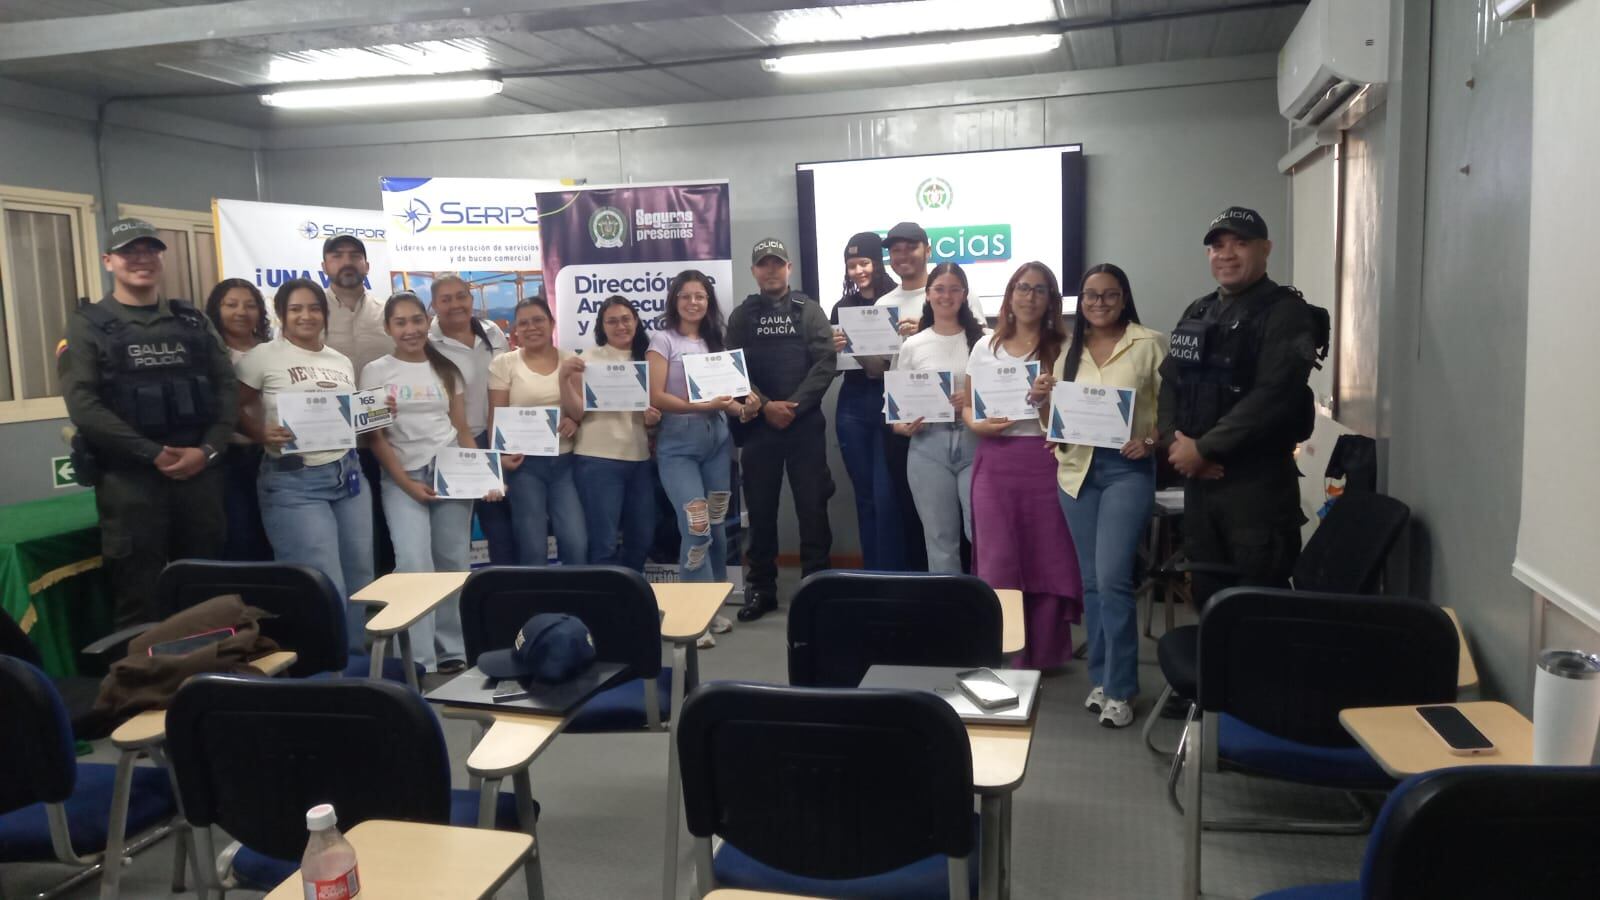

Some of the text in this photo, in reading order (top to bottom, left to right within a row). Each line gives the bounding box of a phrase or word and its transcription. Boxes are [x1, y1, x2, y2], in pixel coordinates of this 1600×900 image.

[636, 209, 693, 228] Seguros
[636, 228, 693, 241] presentes
[439, 243, 447, 251] la
[450, 243, 491, 253] prestación
[493, 243, 502, 251] de
[504, 243, 539, 251] servicios
[754, 241, 784, 252] POLICÍA
[494, 254, 531, 262] comercial
[760, 316, 792, 325] GAULA
[578, 320, 589, 336] y
[757, 325, 796, 335] POLICÍA
[1171, 334, 1198, 348] GAULA
[128, 342, 186, 357] GAULA
[134, 355, 185, 367] POLICÍA
[359, 395, 375, 405] 165
